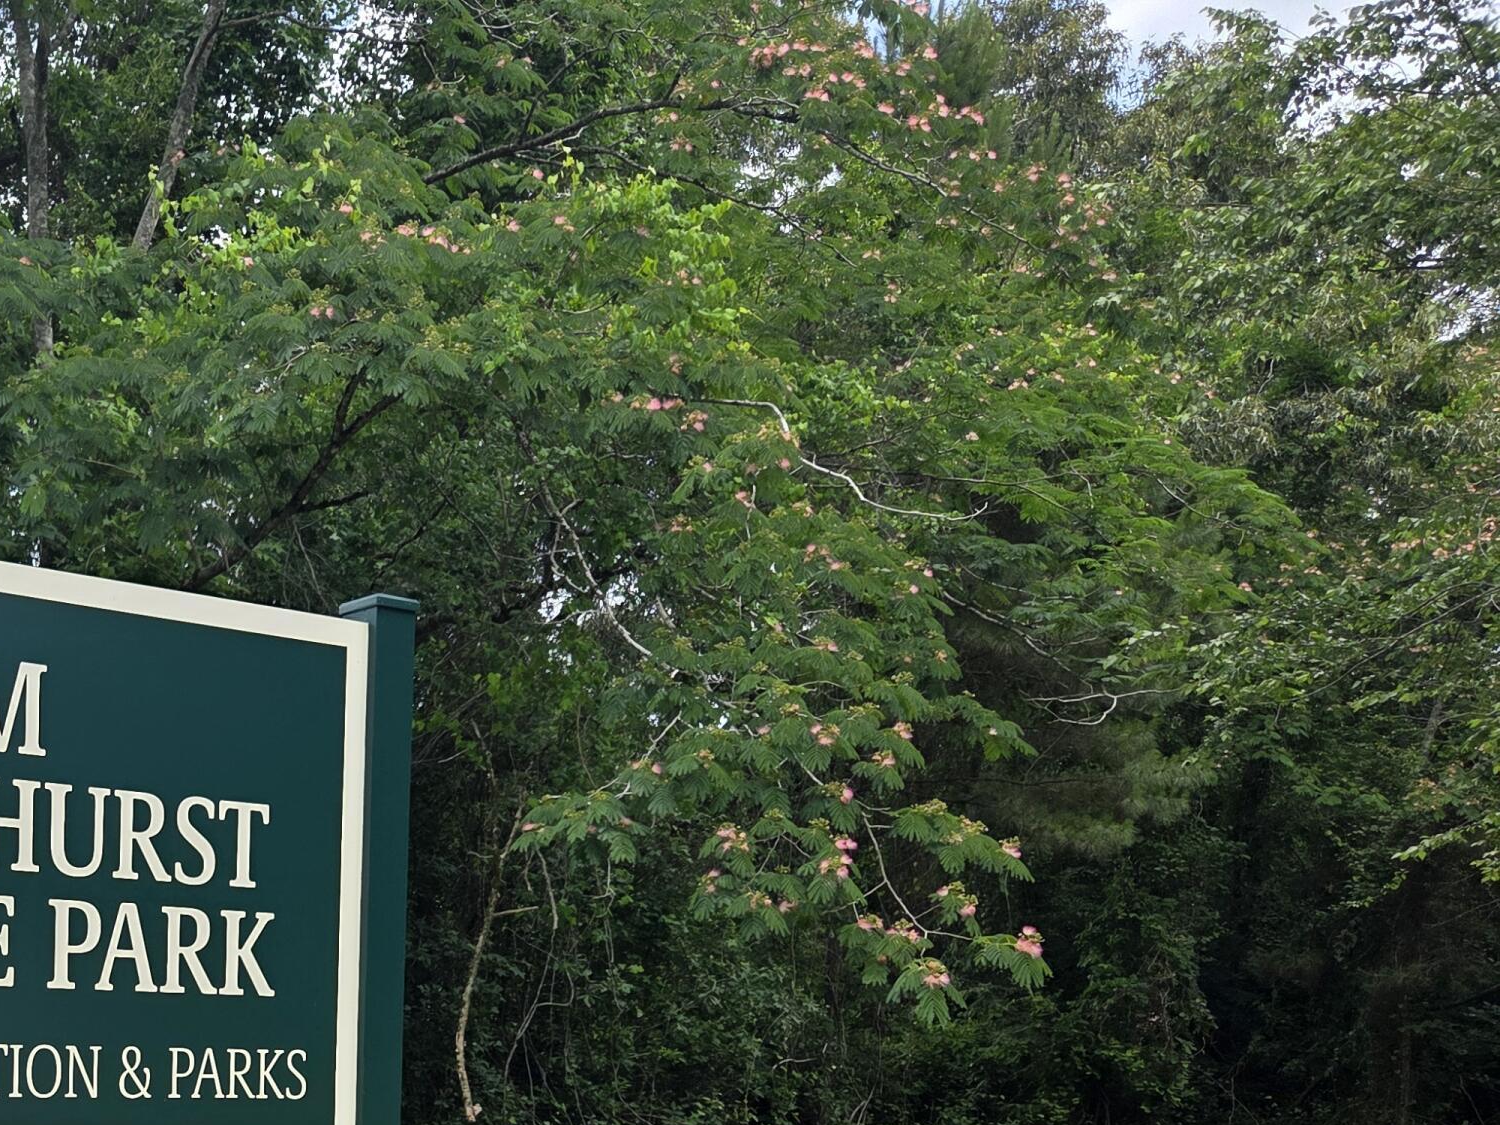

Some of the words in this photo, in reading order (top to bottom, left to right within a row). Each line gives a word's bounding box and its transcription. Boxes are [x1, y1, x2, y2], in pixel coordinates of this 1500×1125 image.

[46, 898, 276, 997] PARK
[118, 1045, 154, 1100] &
[167, 1047, 307, 1100] PARKS
